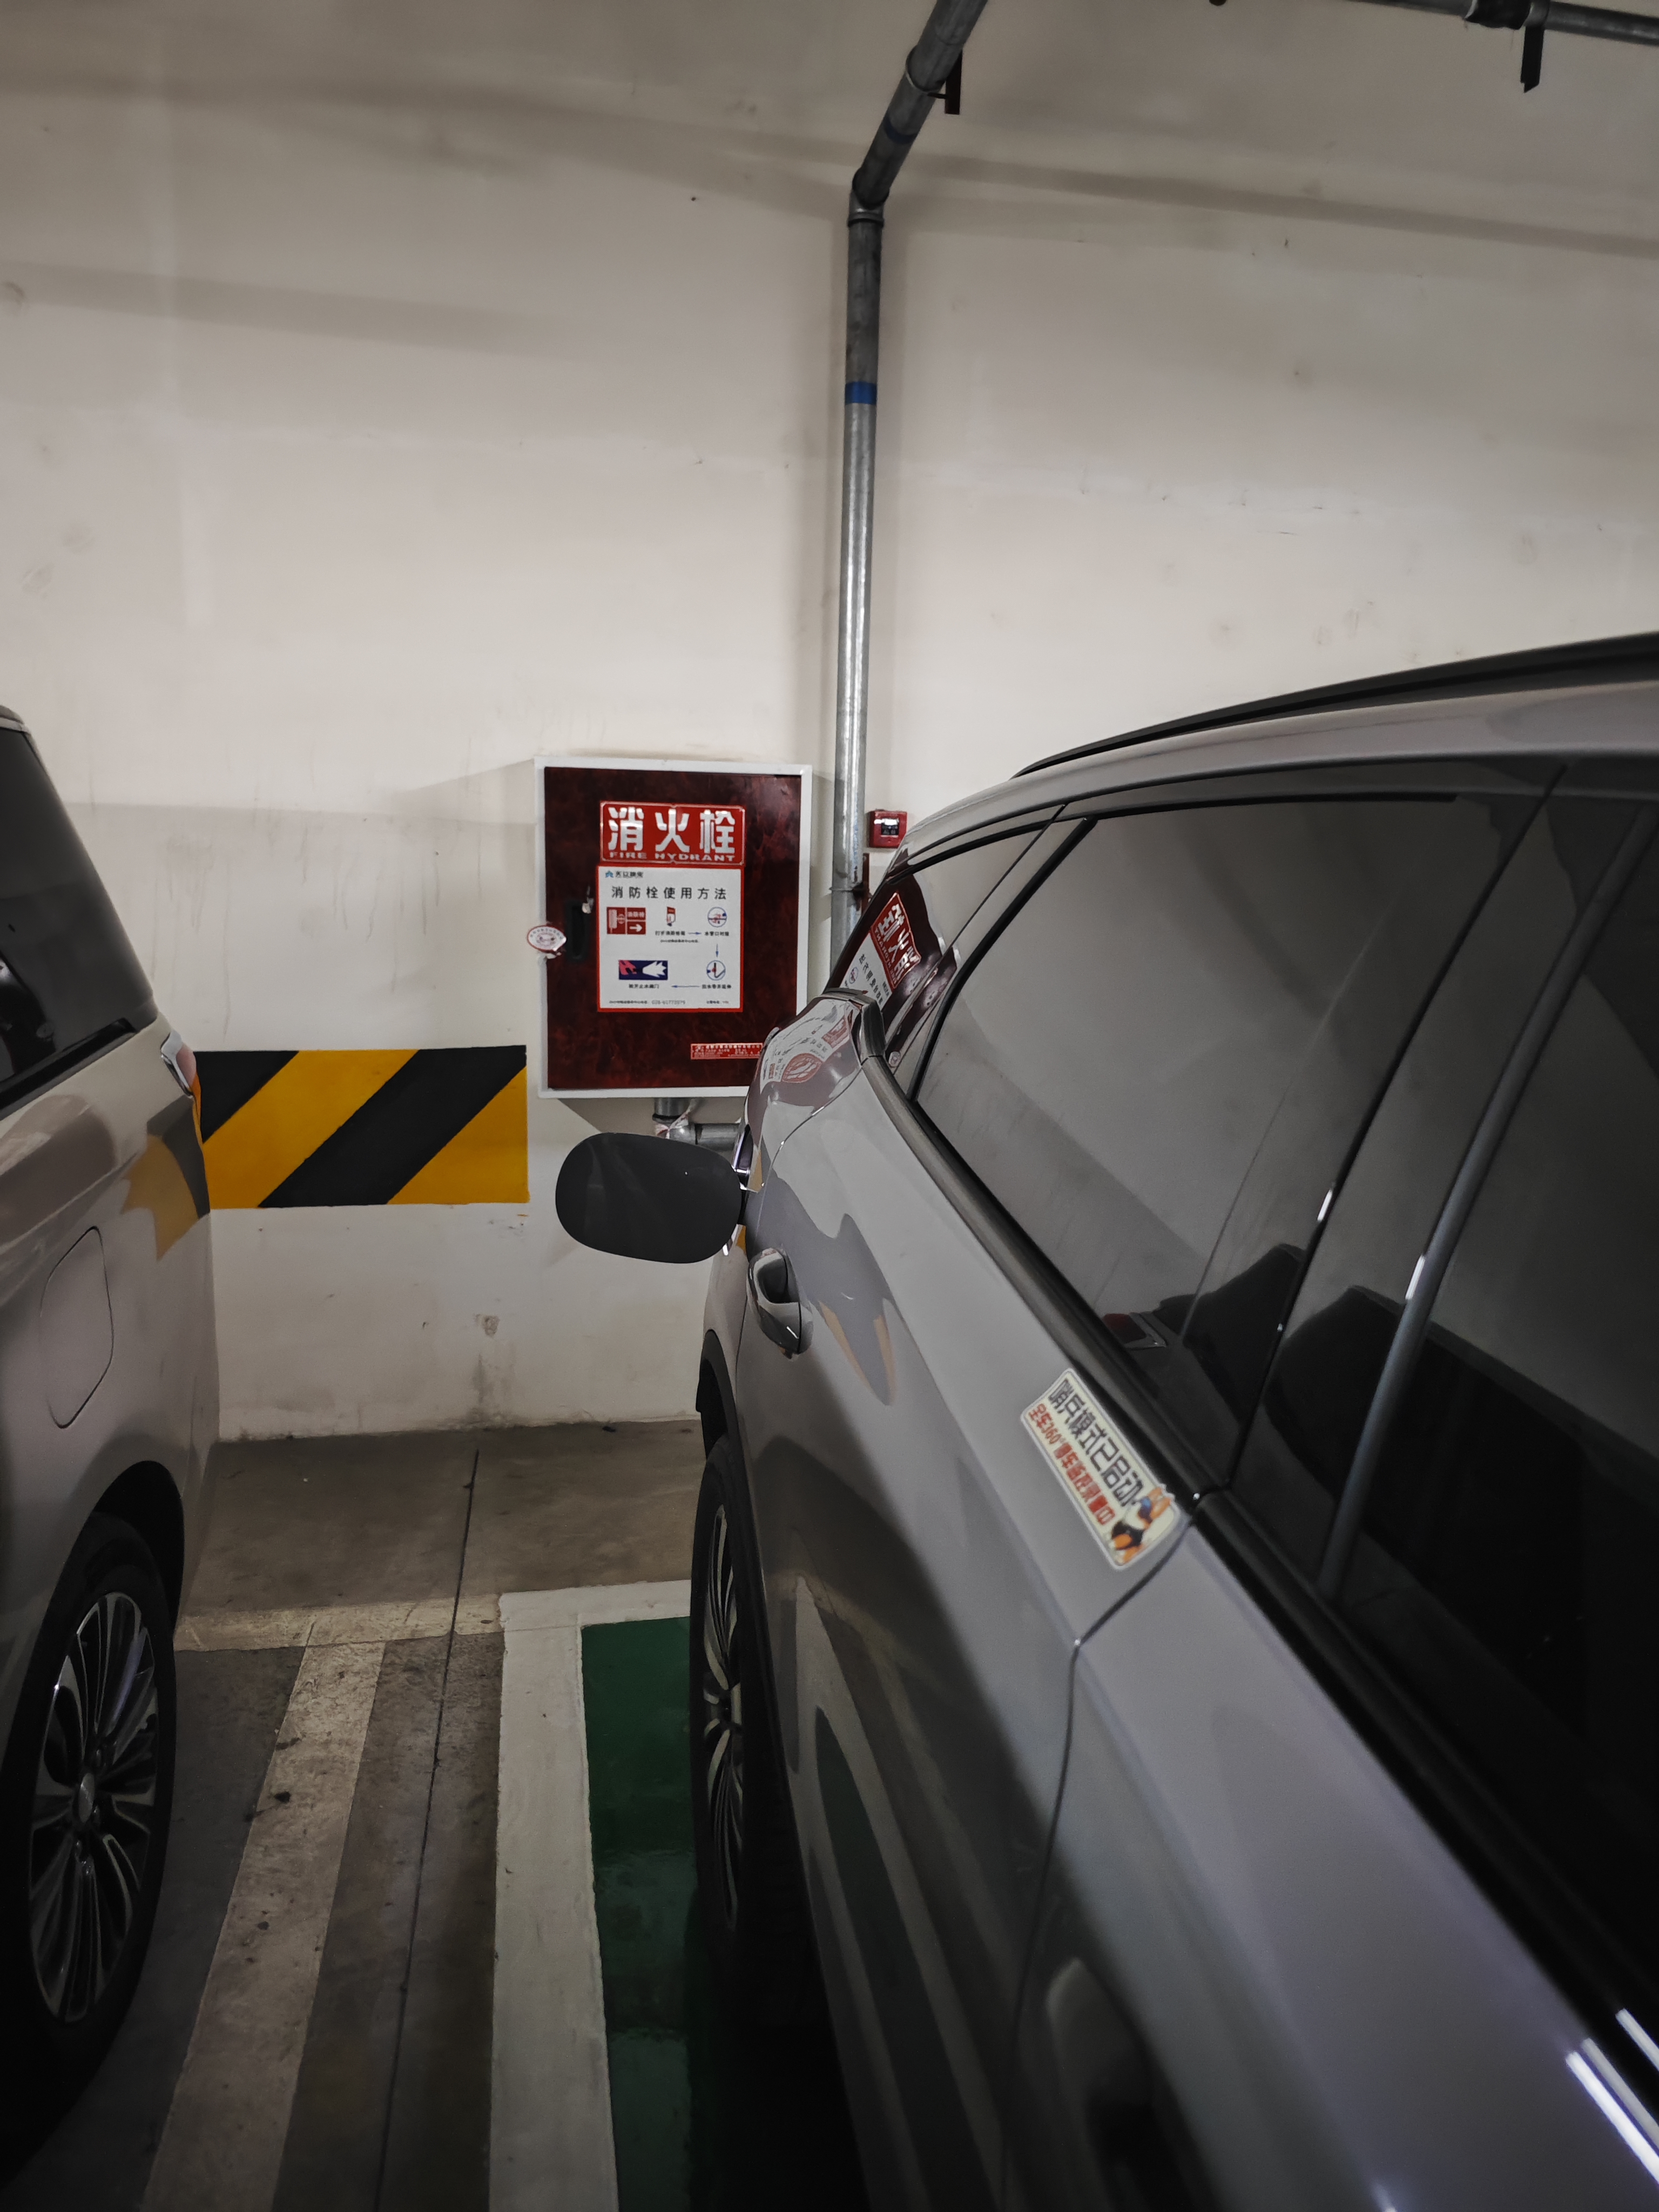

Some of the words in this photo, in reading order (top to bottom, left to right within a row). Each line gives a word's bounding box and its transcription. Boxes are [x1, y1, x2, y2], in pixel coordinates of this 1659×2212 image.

[608, 806, 736, 854] 消火栓
[655, 853, 736, 861] HYDRANT
[611, 886, 726, 900] 消防栓使用方法
[1048, 1378, 1143, 1507] 哨兵模式已启动
